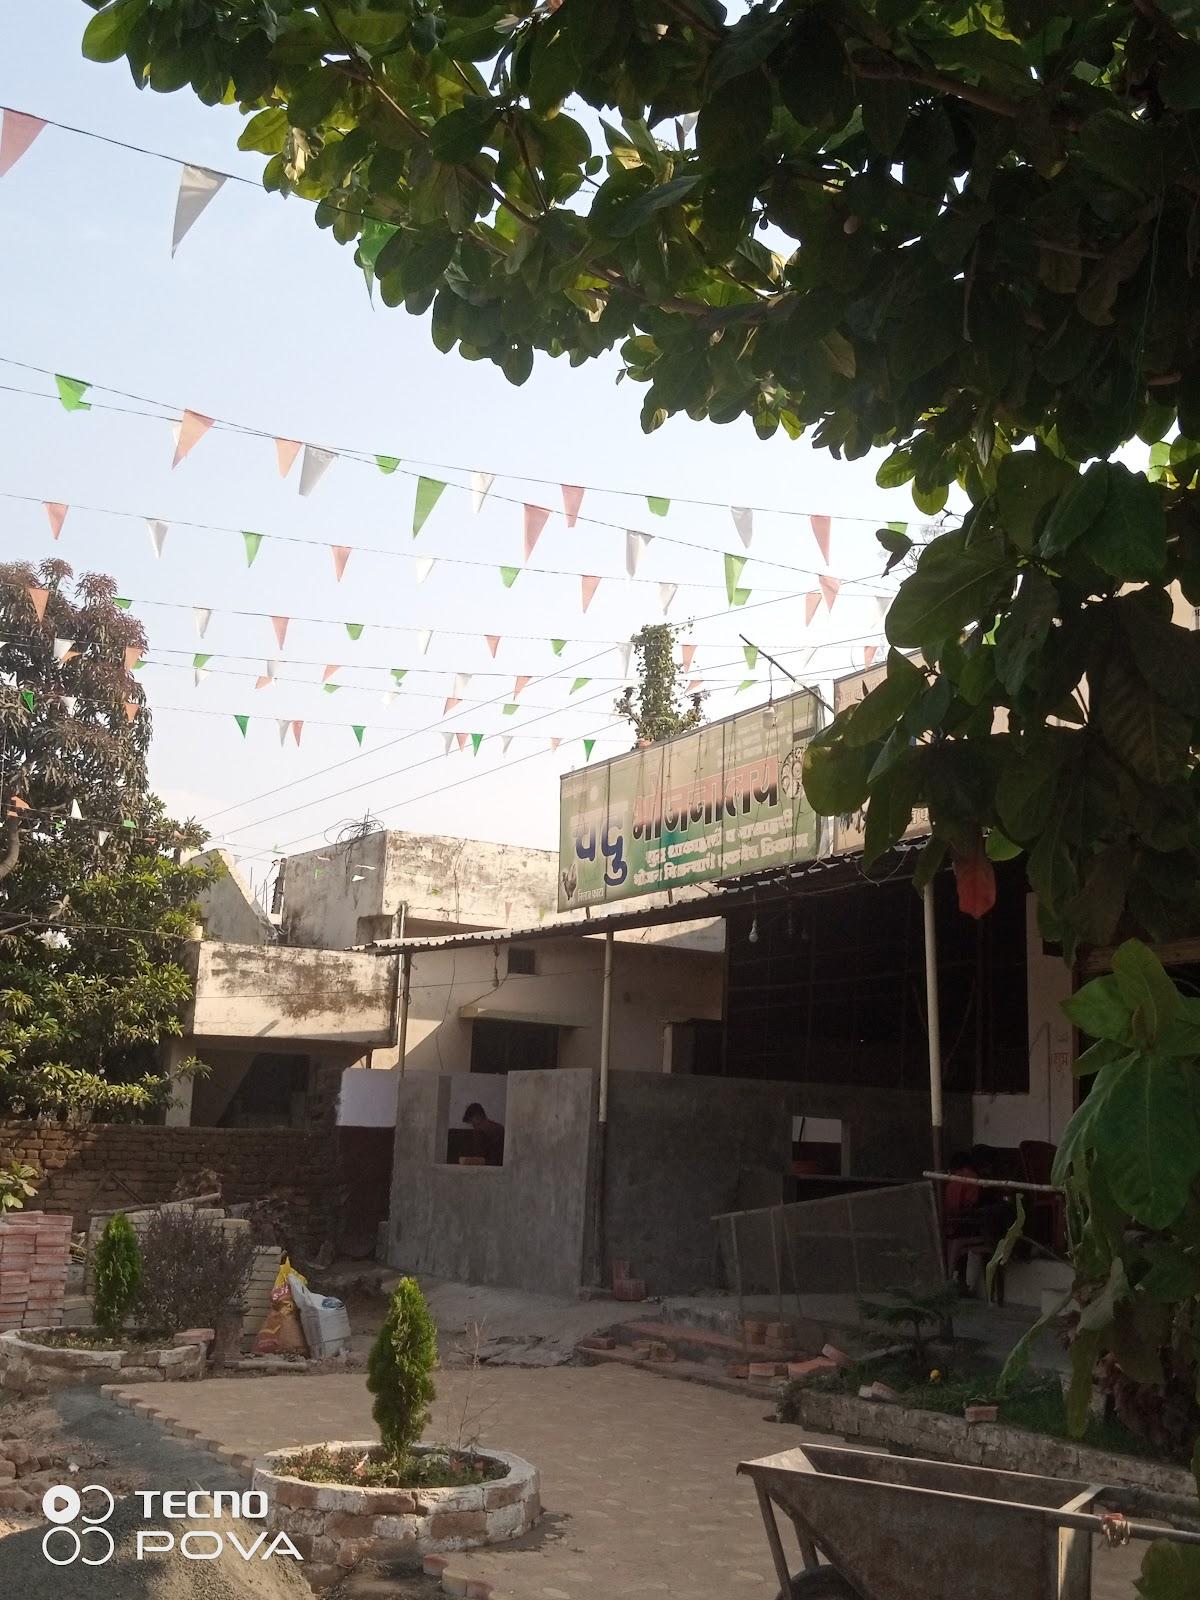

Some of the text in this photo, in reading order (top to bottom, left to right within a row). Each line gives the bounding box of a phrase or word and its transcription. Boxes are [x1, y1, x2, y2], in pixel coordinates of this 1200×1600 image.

[571, 755, 778, 886] यदु भोजनालय
[668, 828, 722, 858] शाकाहारी
